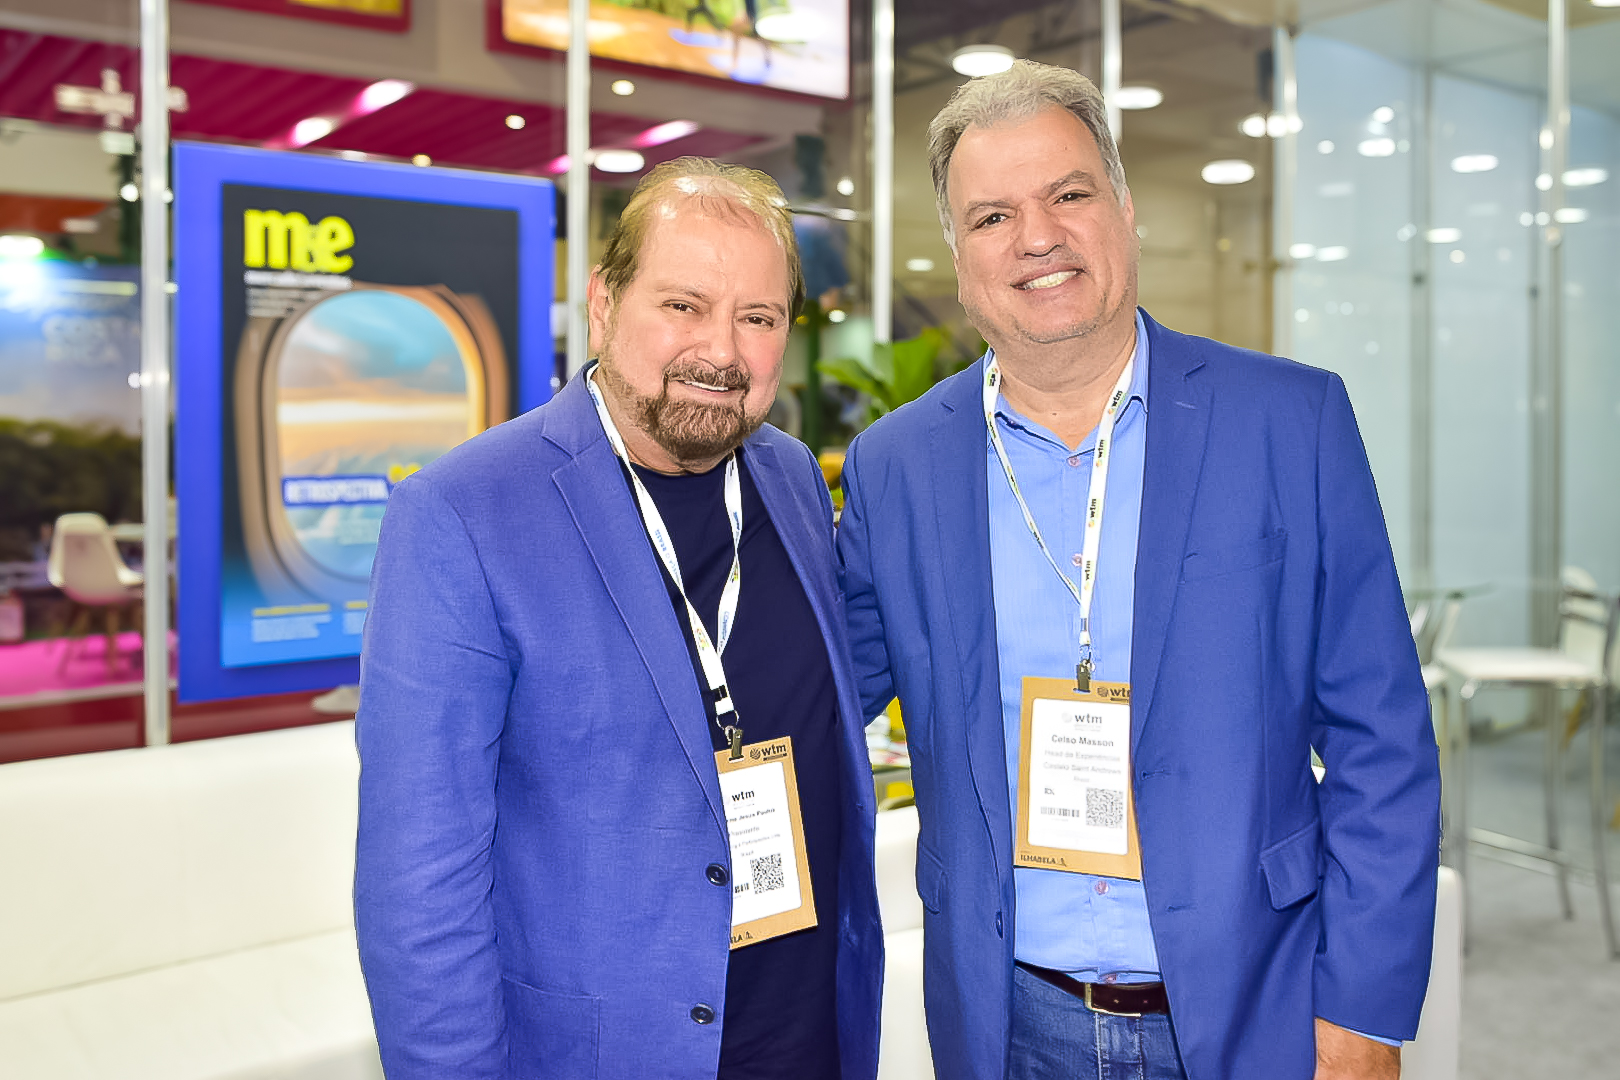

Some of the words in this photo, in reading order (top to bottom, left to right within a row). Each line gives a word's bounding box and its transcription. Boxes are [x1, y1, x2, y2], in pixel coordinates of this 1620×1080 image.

[1074, 713, 1103, 724] wtm
[1051, 734, 1077, 745] Celso
[1078, 736, 1114, 747] Masson
[760, 743, 786, 757] wtm
[731, 790, 755, 802] wtm
